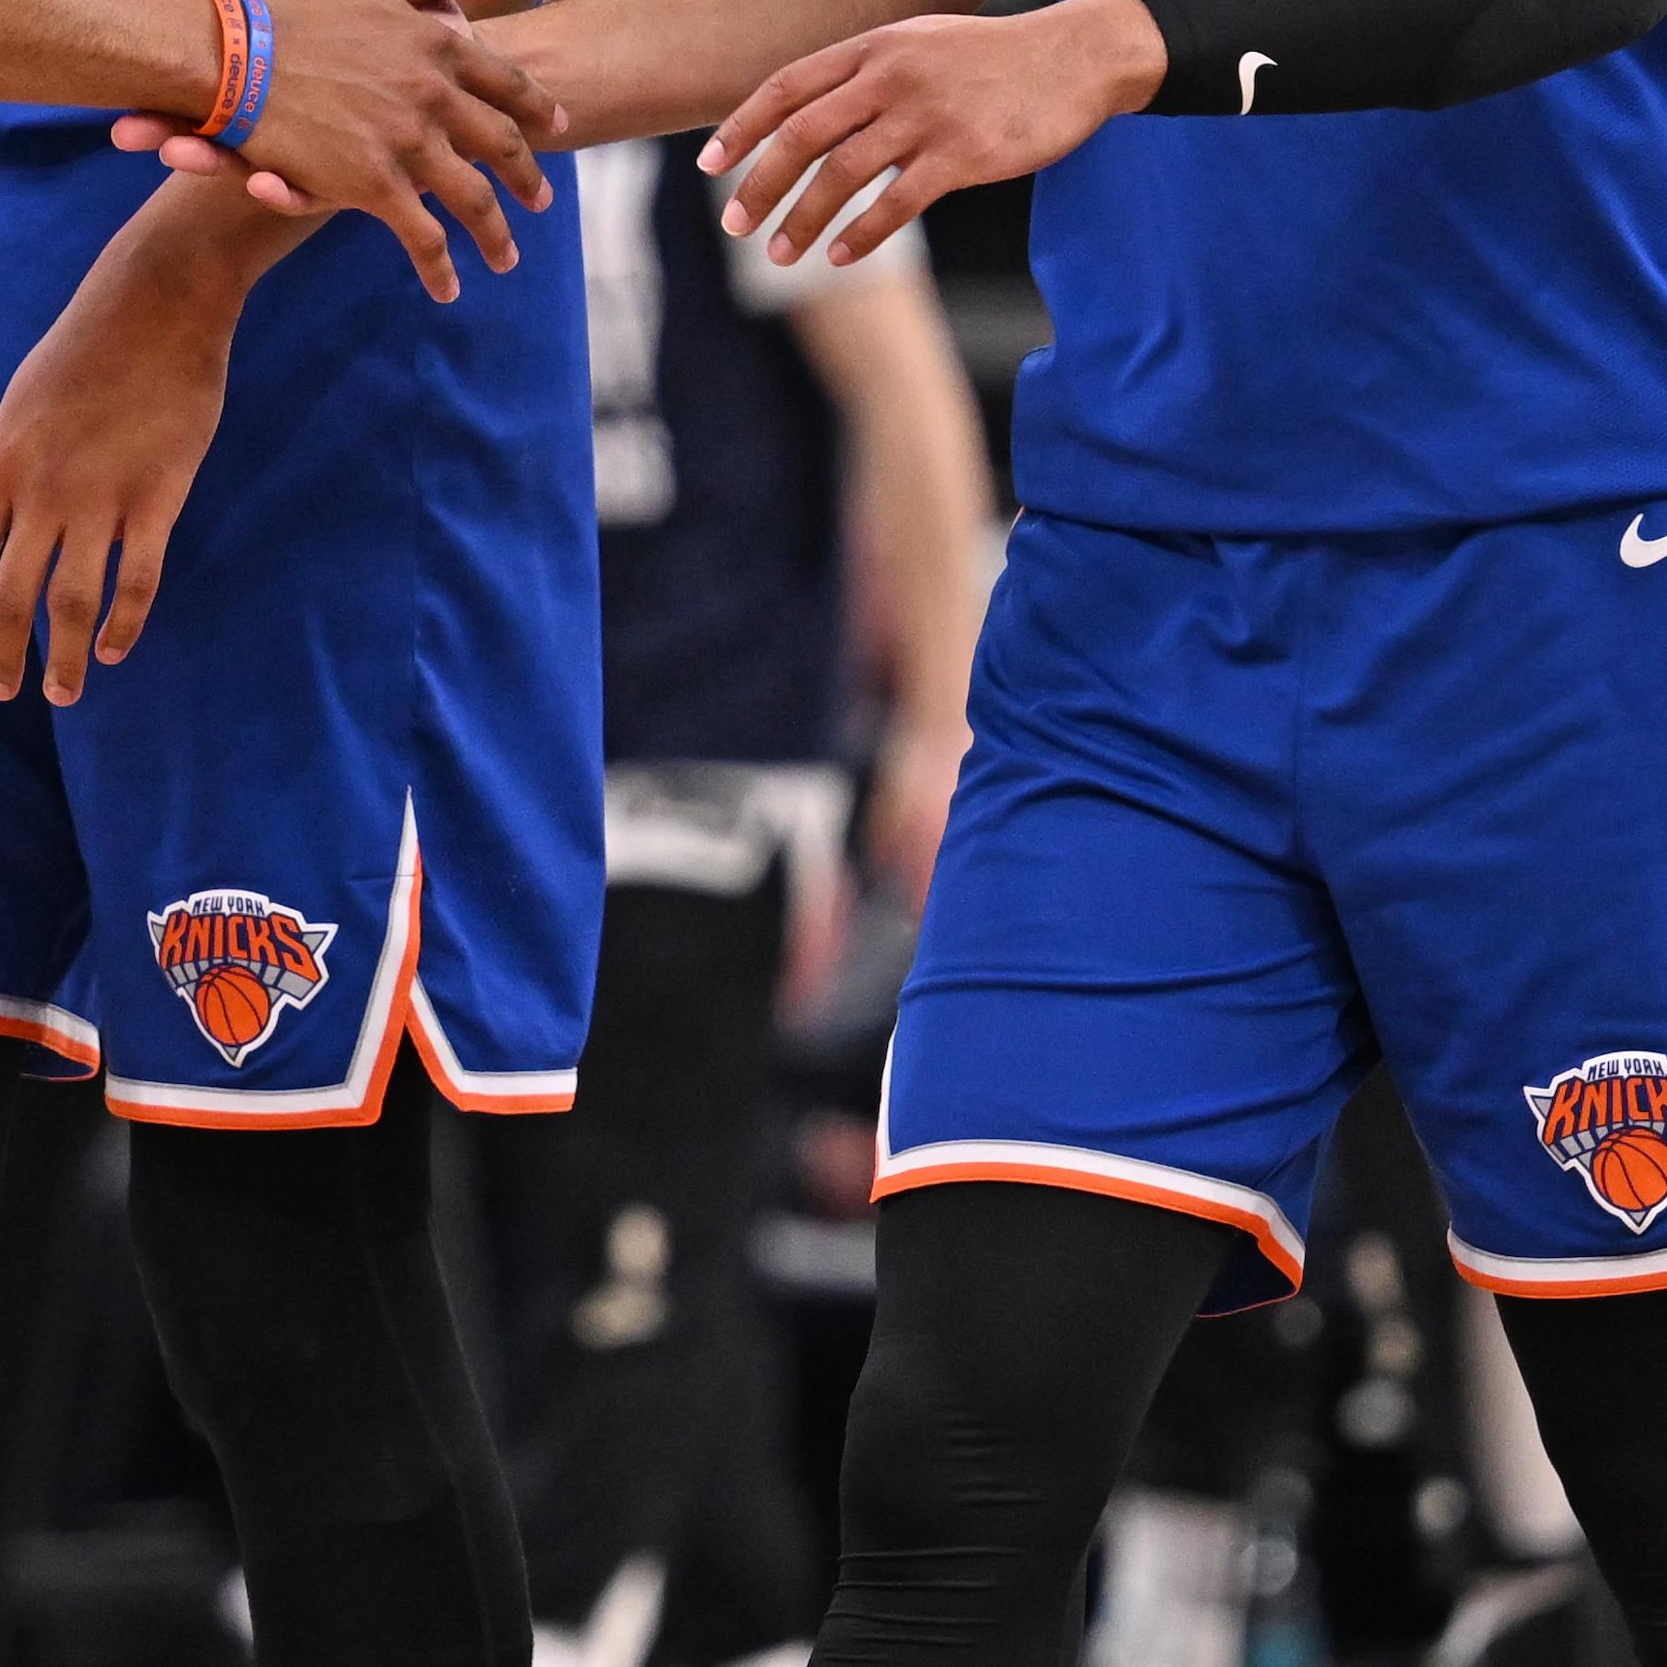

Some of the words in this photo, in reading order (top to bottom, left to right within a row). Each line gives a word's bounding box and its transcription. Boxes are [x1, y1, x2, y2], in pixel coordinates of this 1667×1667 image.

[243, 56, 267, 113] deuce
[192, 896, 223, 915] NEW
[227, 895, 266, 916] YORK
[159, 910, 322, 984] KNICKS
[1587, 1059, 1620, 1081] NEW
[1623, 1057, 1665, 1076] YORK
